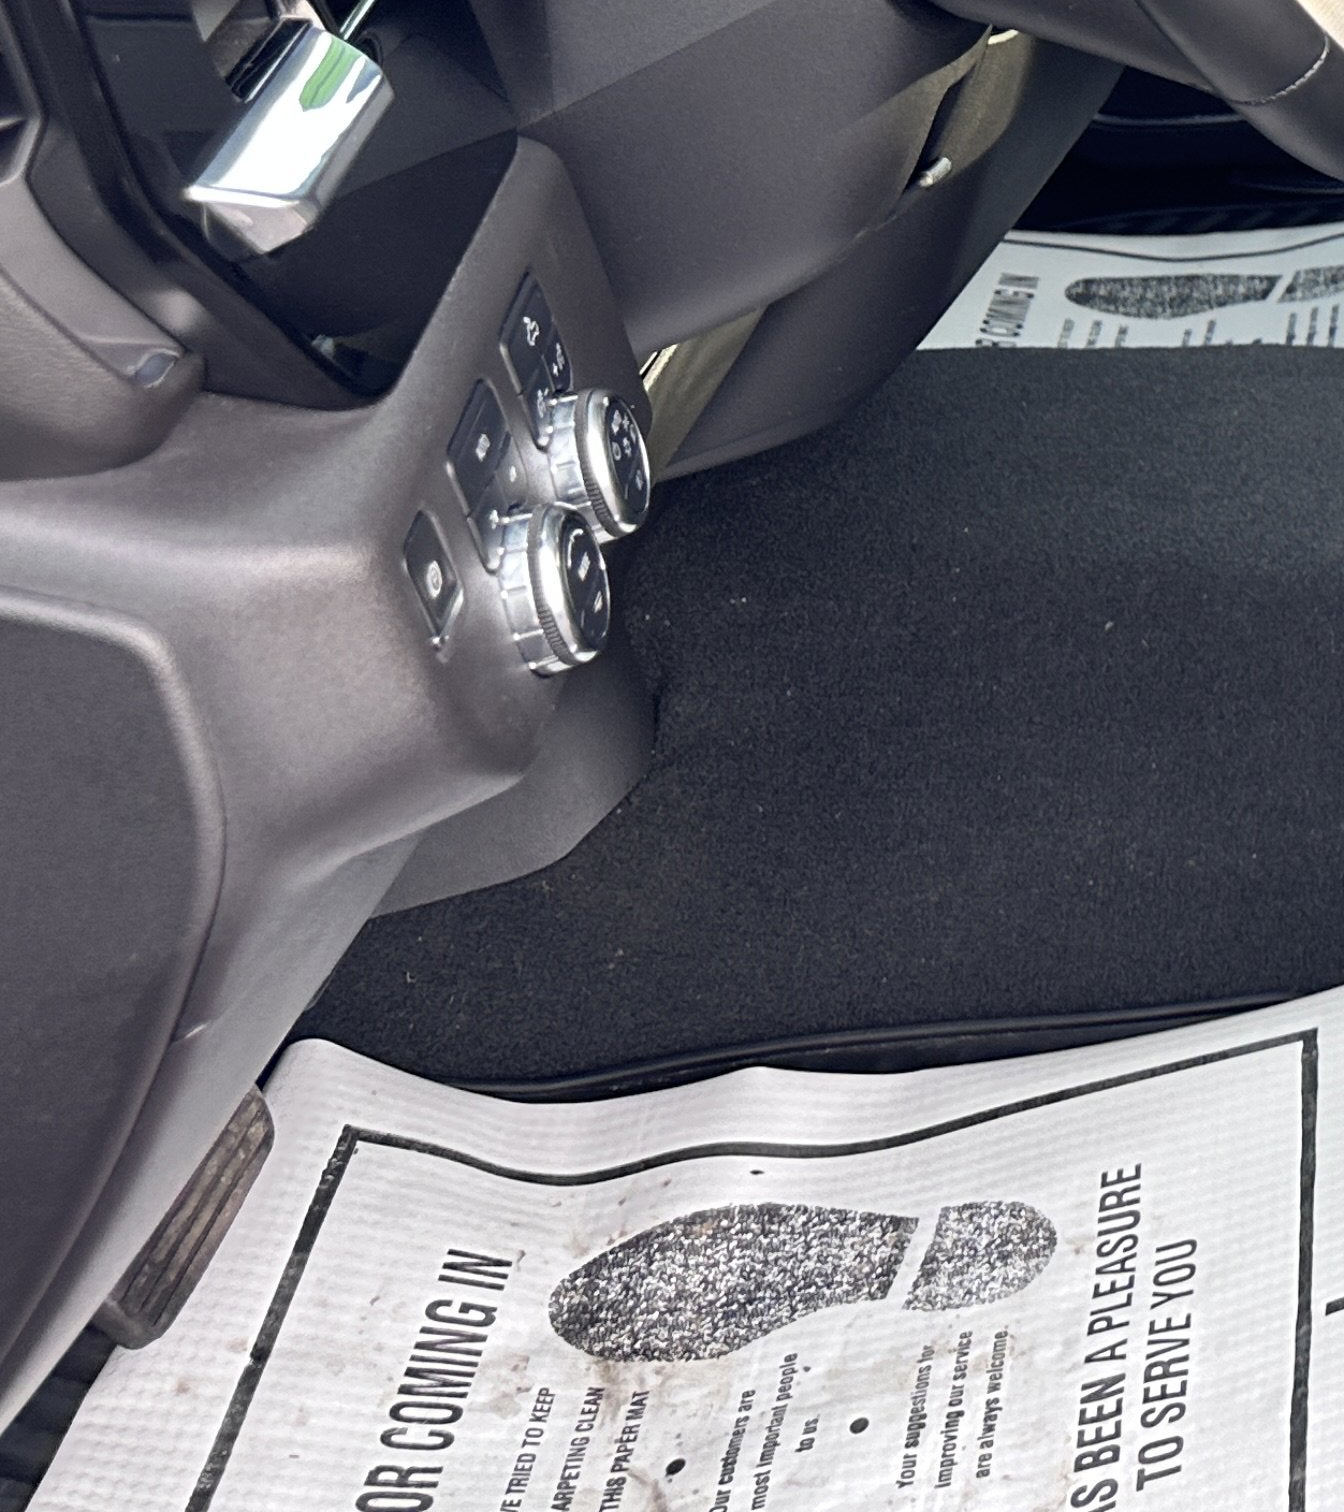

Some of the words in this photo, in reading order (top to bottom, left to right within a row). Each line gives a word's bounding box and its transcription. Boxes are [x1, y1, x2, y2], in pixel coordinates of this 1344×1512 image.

[438, 1248, 512, 1291] IN
[1087, 1163, 1142, 1336] PLEASURE
[1150, 1238, 1198, 1310] YOU
[917, 1345, 935, 1364] for
[953, 1330, 973, 1382] service
[1084, 1338, 1128, 1364] A
[1140, 1313, 1191, 1428] SERVE
[380, 1299, 498, 1450] COMING
[948, 1384, 965, 1407] our
[529, 1387, 556, 1423] KEEP
[575, 1387, 605, 1432] CLEAN
[625, 1390, 650, 1421] MAT
[904, 1364, 932, 1449] suggestions
[977, 1397, 1003, 1450] always
[1074, 1373, 1126, 1473] BEEN
[521, 1427, 545, 1448] TO
[610, 1423, 641, 1473] PAPER
[718, 1415, 749, 1485] customers
[738, 1389, 756, 1412] are
[751, 1470, 771, 1510] most
[775, 1353, 798, 1401] people
[794, 1437, 815, 1452] to
[505, 1453, 536, 1494] TRIED
[896, 1453, 917, 1489] Your
[976, 1452, 992, 1478] are
[1136, 1436, 1184, 1493] TO
[599, 1476, 626, 1512] THIS
